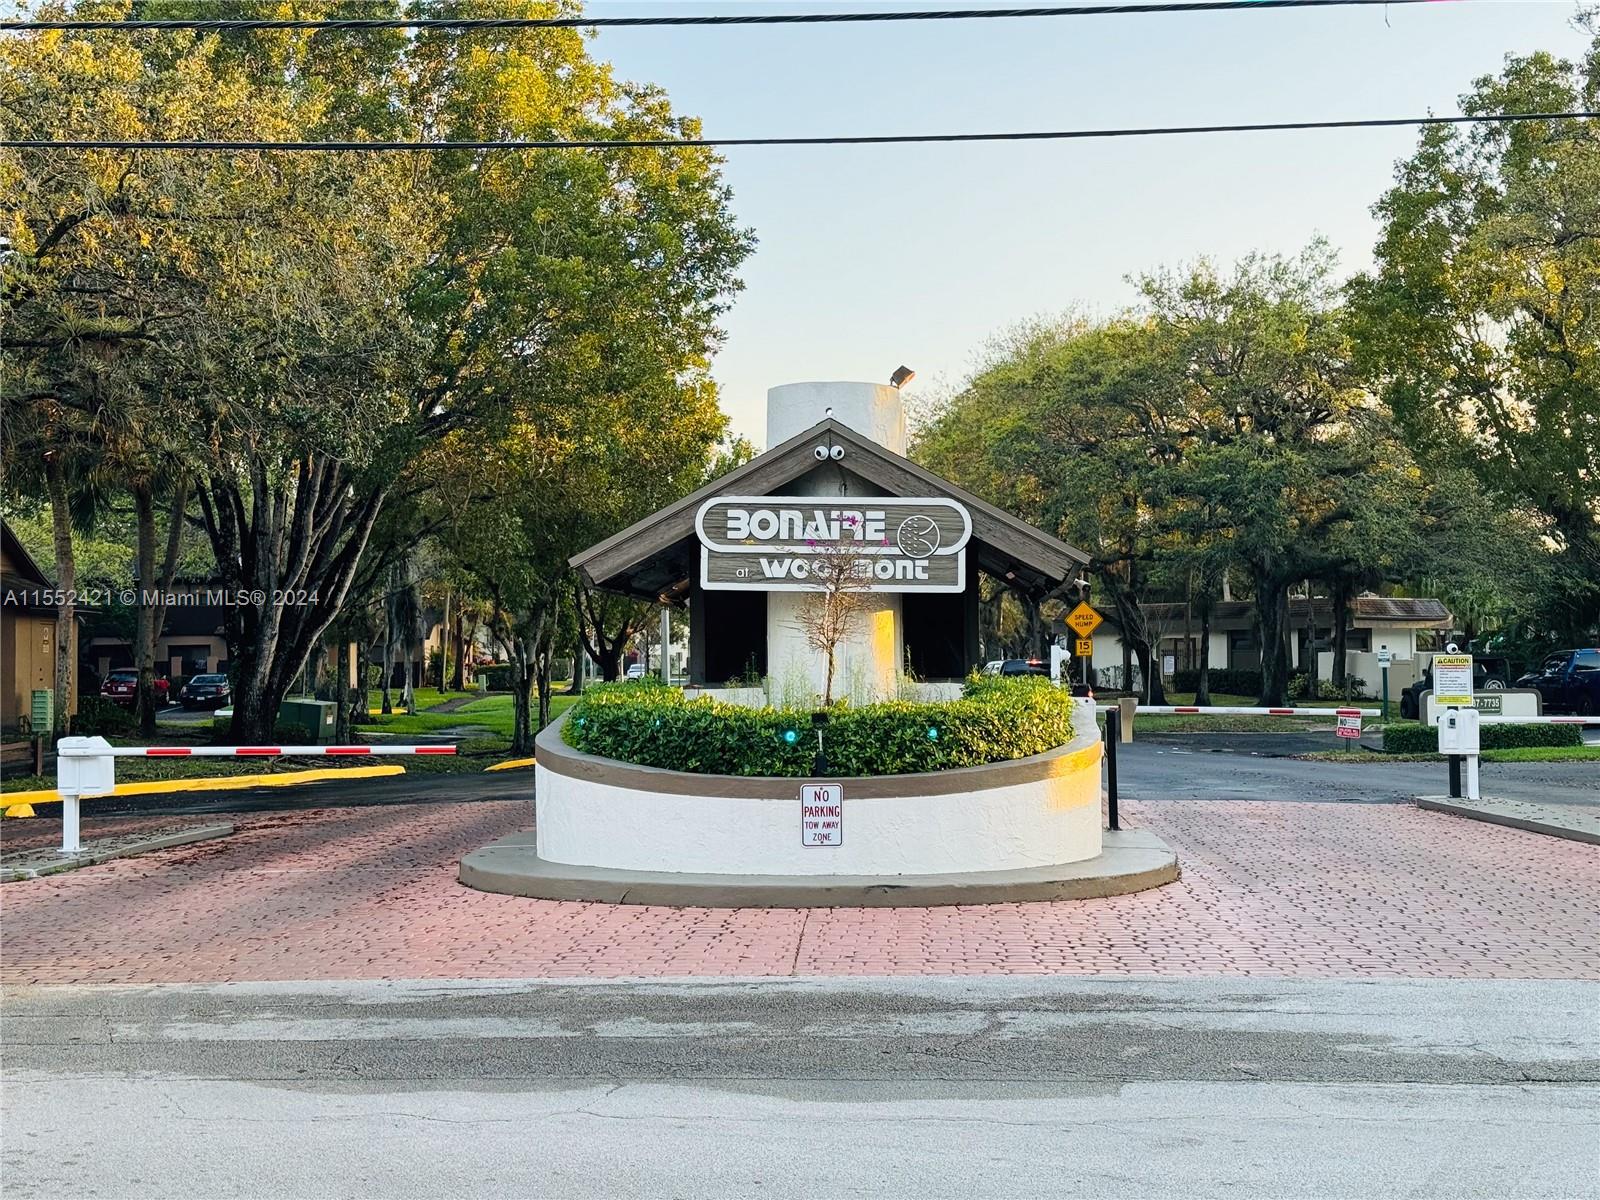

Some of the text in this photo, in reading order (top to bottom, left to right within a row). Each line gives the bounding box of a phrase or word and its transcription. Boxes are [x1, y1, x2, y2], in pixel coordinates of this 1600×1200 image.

[726, 509, 886, 541] BONAIRE
[735, 566, 749, 578] at
[1079, 641, 1090, 650] 15
[814, 790, 829, 801] NO
[804, 805, 840, 818] PARKING
[805, 821, 839, 829] TOW AWAY
[812, 832, 832, 841] ZONE
